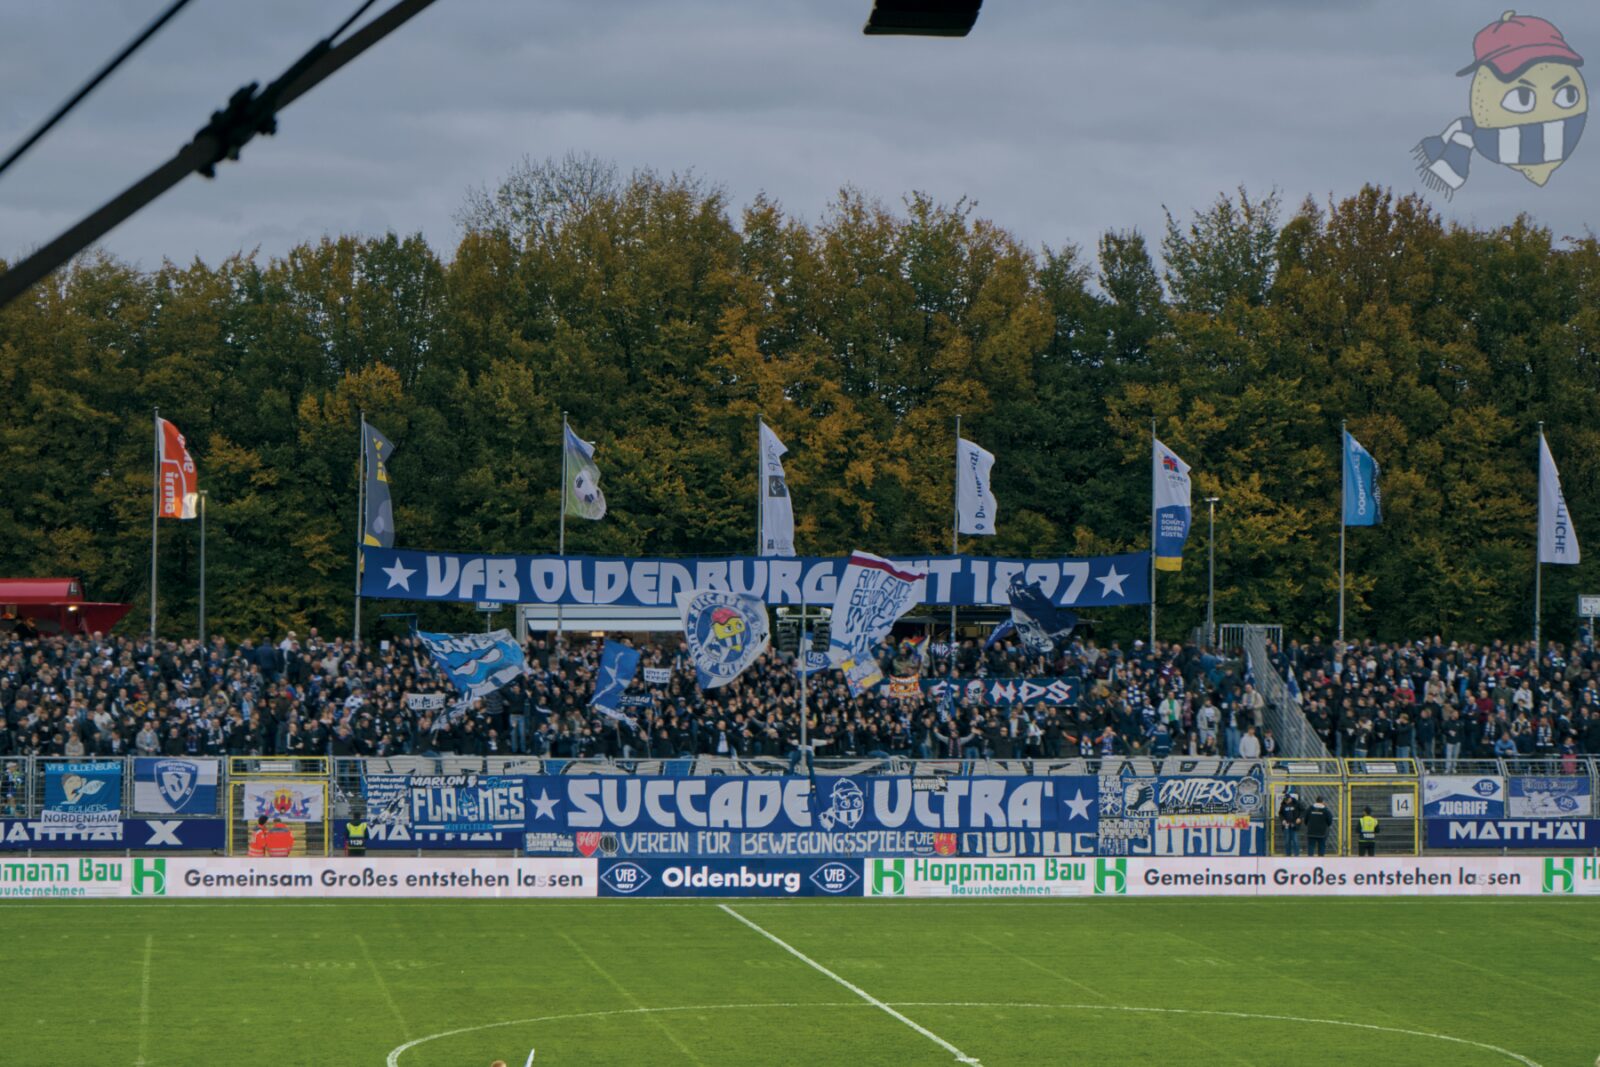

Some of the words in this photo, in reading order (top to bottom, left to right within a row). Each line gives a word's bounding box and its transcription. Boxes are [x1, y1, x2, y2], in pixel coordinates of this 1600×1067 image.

[530, 558, 838, 605] OLDENBURG
[971, 559, 1092, 605] 1897
[411, 775, 466, 787] MARLON
[1159, 778, 1238, 807] CRITTERS
[413, 787, 525, 822] FLAMES
[568, 778, 812, 828] SUCCADE
[1396, 799, 1409, 811] 14
[1439, 801, 1489, 815] ZUGRIFF
[44, 814, 118, 823] NORDENHAM
[1125, 810, 1158, 818] UNITE
[1449, 821, 1586, 840] MATTHÄI
[620, 831, 689, 854] VEREIN
[0, 862, 69, 882] mann
[78, 858, 123, 882] Bau
[184, 868, 314, 888] Gemeinsam
[320, 867, 399, 888] Großes
[405, 868, 510, 888] entstehen
[517, 868, 583, 888] lassen
[615, 869, 638, 882] VfB
[662, 866, 802, 893] Oldenburg
[824, 869, 846, 882] VfB
[914, 858, 1036, 886] Hoppmann
[1045, 858, 1086, 881] Bau
[1144, 867, 1266, 887] Gemeinsam
[1272, 867, 1347, 887] Großes
[1353, 867, 1452, 887] entstehen
[1459, 867, 1522, 886] lassen
[952, 885, 1051, 896] Bauunternehmen
